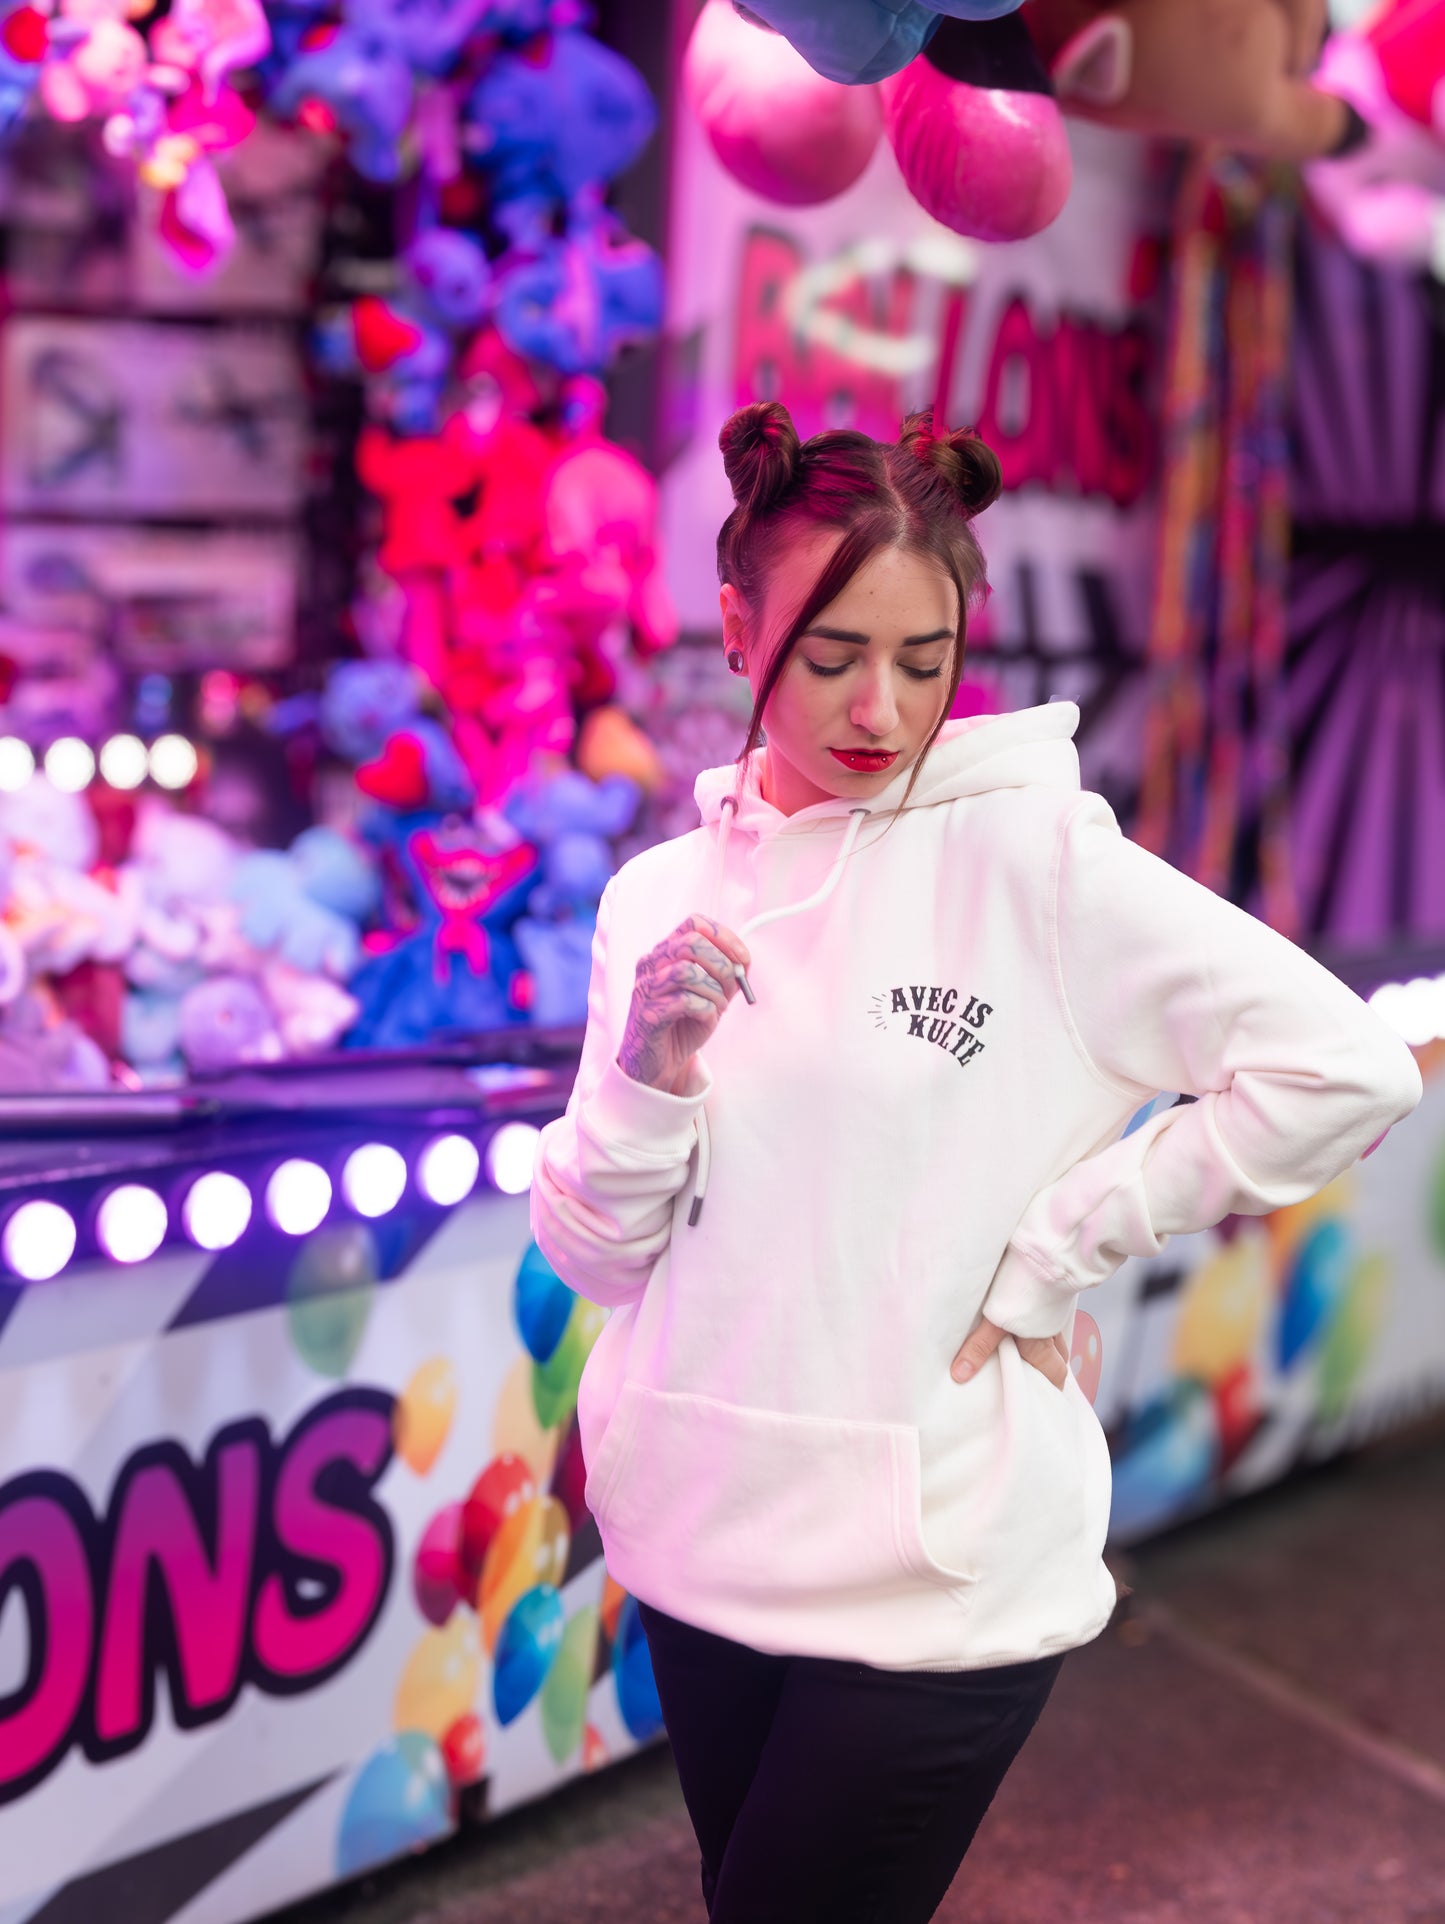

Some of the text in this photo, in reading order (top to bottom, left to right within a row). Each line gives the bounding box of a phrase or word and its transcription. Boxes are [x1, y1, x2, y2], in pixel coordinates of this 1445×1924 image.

[890, 985, 994, 1028] AVEC IS
[906, 1013, 985, 1068] KULTE
